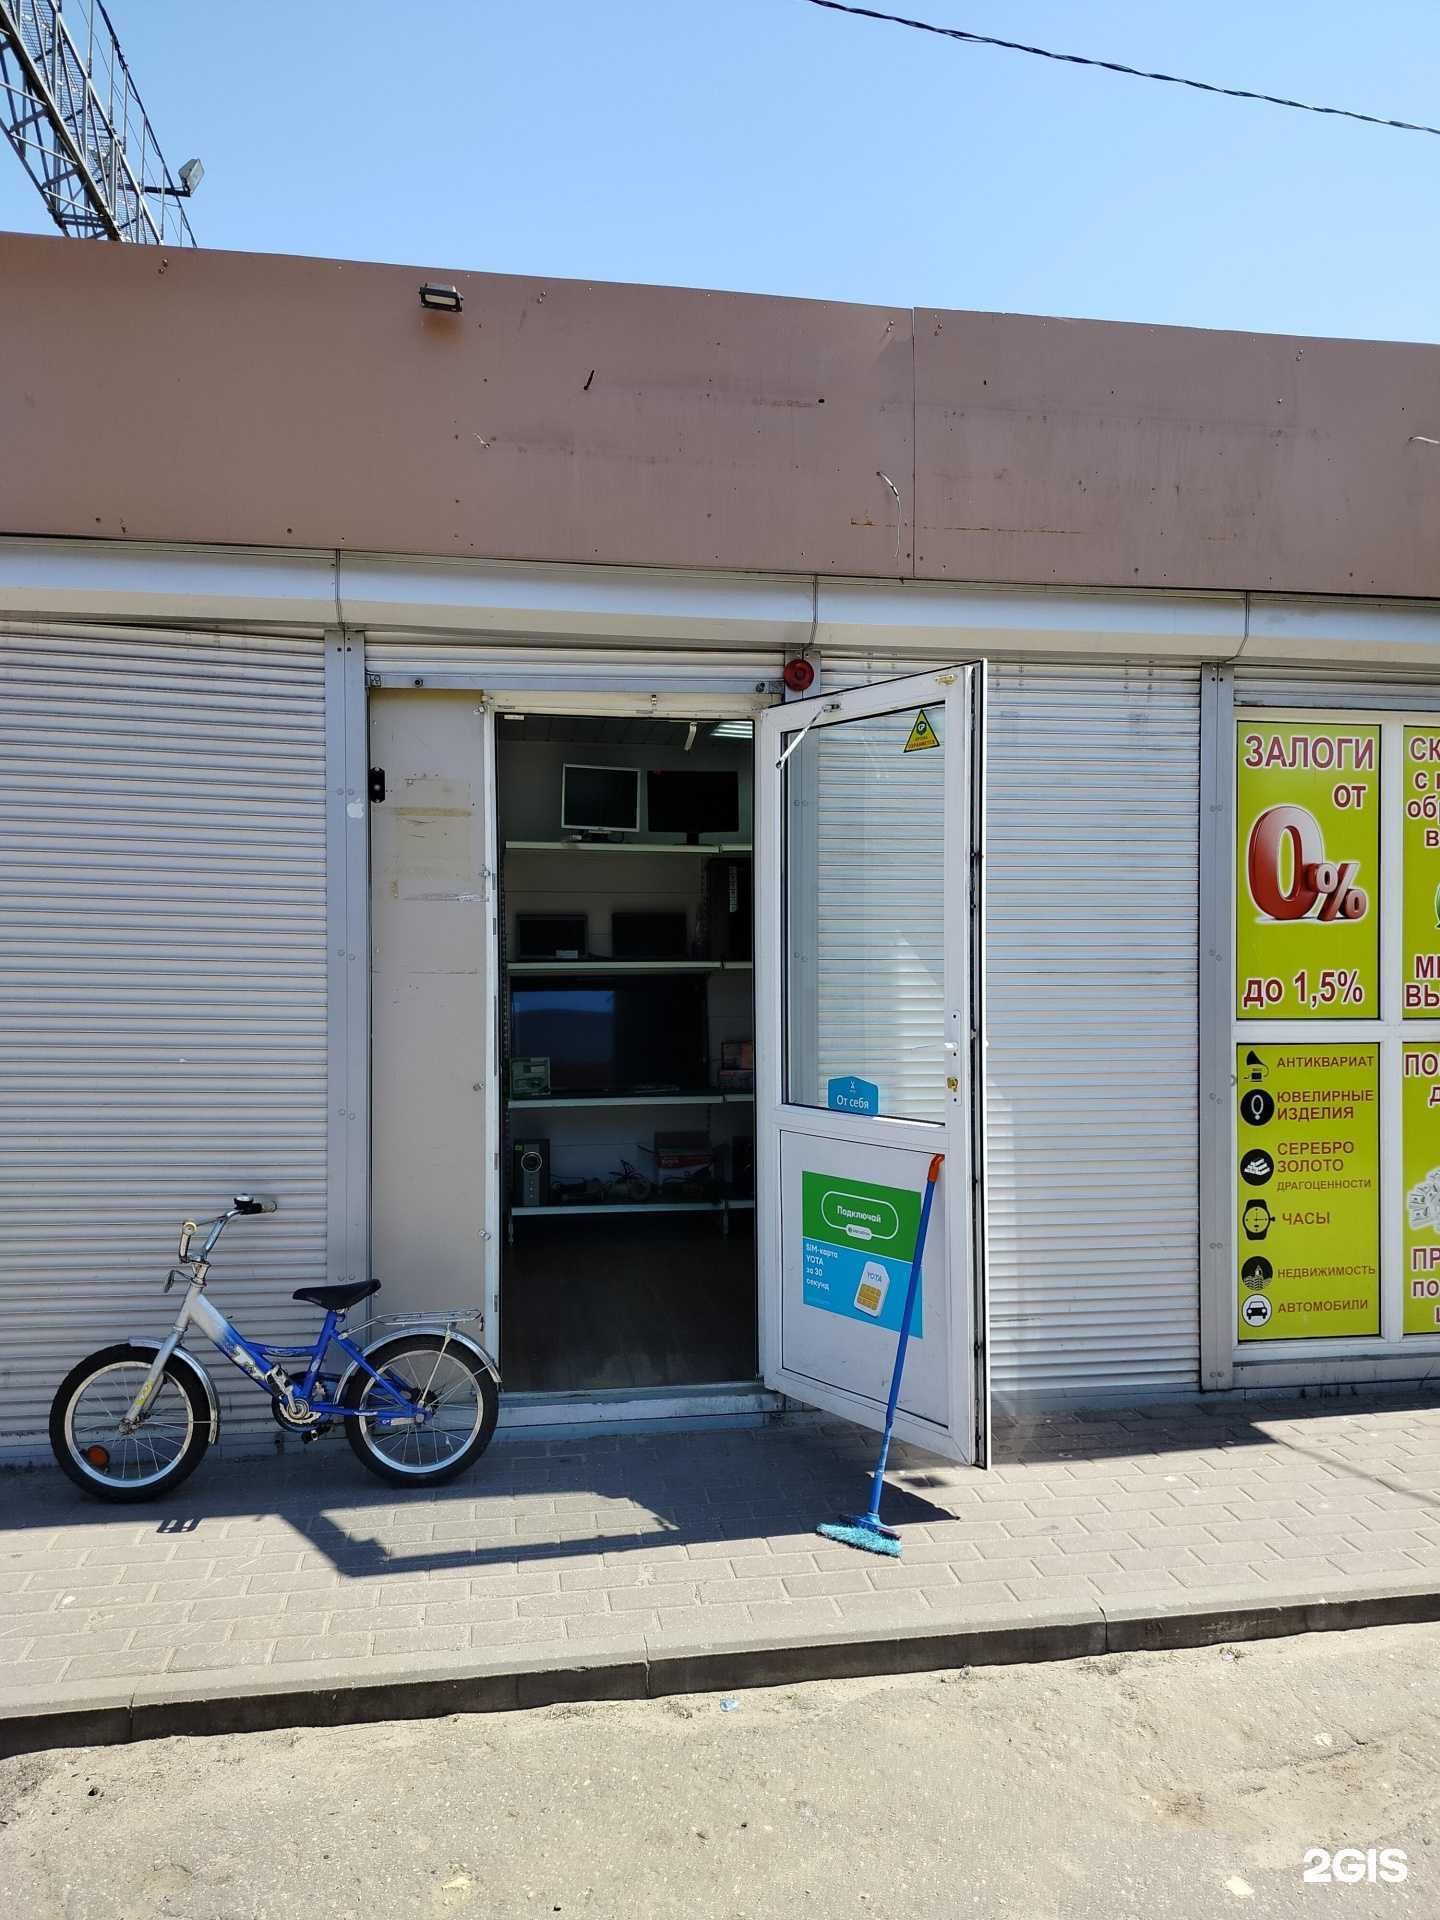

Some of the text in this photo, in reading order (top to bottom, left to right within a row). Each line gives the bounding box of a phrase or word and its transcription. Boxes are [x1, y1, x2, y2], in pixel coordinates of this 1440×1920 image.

[1245, 735, 1374, 770] ЗАЛОГИ
[1333, 785, 1366, 808] от
[1247, 805, 1368, 921] 0%
[1243, 970, 1364, 1008] до 1,5%
[1276, 1055, 1375, 1069] АНТИКВАРИАТ
[836, 1094, 869, 1110] От себя
[1276, 1090, 1374, 1104] ЮВЕЛИРНЫЕ
[1276, 1106, 1354, 1122] ИЗДЕЛИЯ
[1277, 1141, 1355, 1156] СЕРЕБРО
[1277, 1159, 1345, 1173] ЗОЛОТО
[1276, 1179, 1372, 1193] ДРАГОЦЕННОСТИ
[836, 1204, 882, 1223] Подключай
[1282, 1212, 1331, 1226] ЧАСЫ
[806, 1243, 838, 1259] SIM-карта
[806, 1255, 824, 1266] YOTA
[814, 1267, 823, 1276] 30
[867, 1271, 882, 1282] YOTA
[1277, 1265, 1376, 1280] НЕДВИЖИМОСТЬ
[806, 1279, 830, 1292] секунд
[1277, 1299, 1369, 1314] АВТОМОБИЛИ
